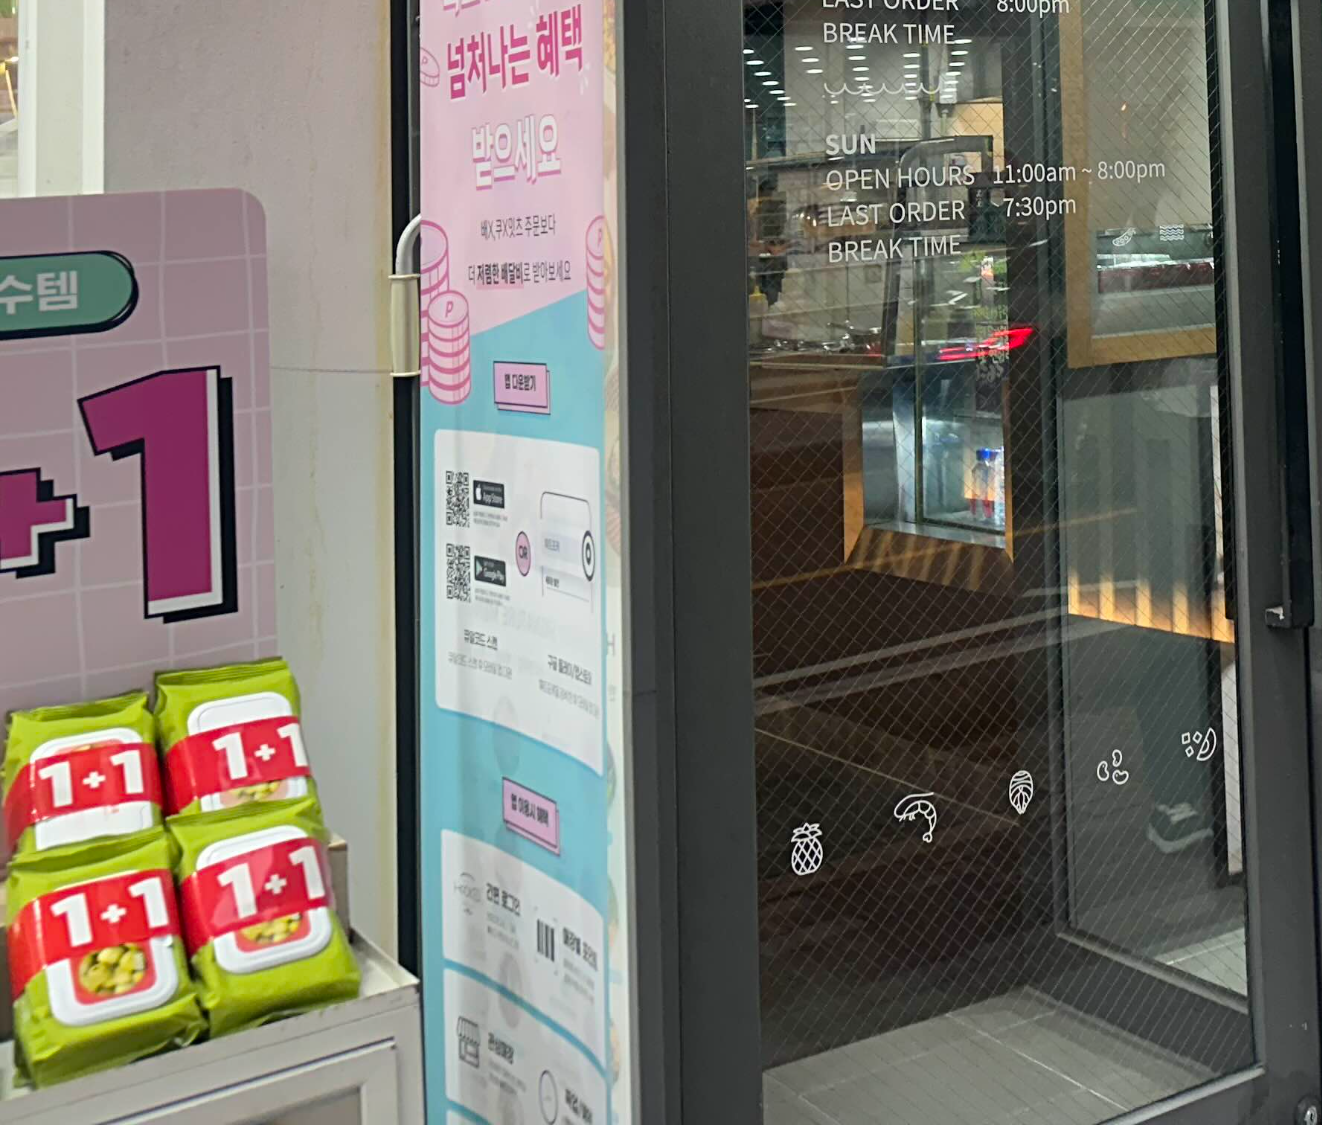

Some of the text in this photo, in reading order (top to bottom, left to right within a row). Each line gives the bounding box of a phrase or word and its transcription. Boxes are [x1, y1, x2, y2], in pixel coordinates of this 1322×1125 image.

[447, 4, 583, 100] 넘쳐나는 혜택
[823, 22, 955, 45] BREAK TIME
[471, 113, 562, 191] 받으세요
[825, 133, 876, 155] SUN
[826, 168, 889, 191] OPEN
[898, 165, 975, 188] HOURS
[993, 163, 1076, 184] 11:00am
[1097, 160, 1166, 183] 8:00pm
[828, 196, 1077, 227] LAST ORDER 7:30pm
[829, 235, 962, 263] BREAK TIME
[38, 749, 145, 809] 1+1
[213, 721, 308, 781] 1+1
[51, 876, 171, 948] 1+1
[217, 844, 326, 920] 1+1
